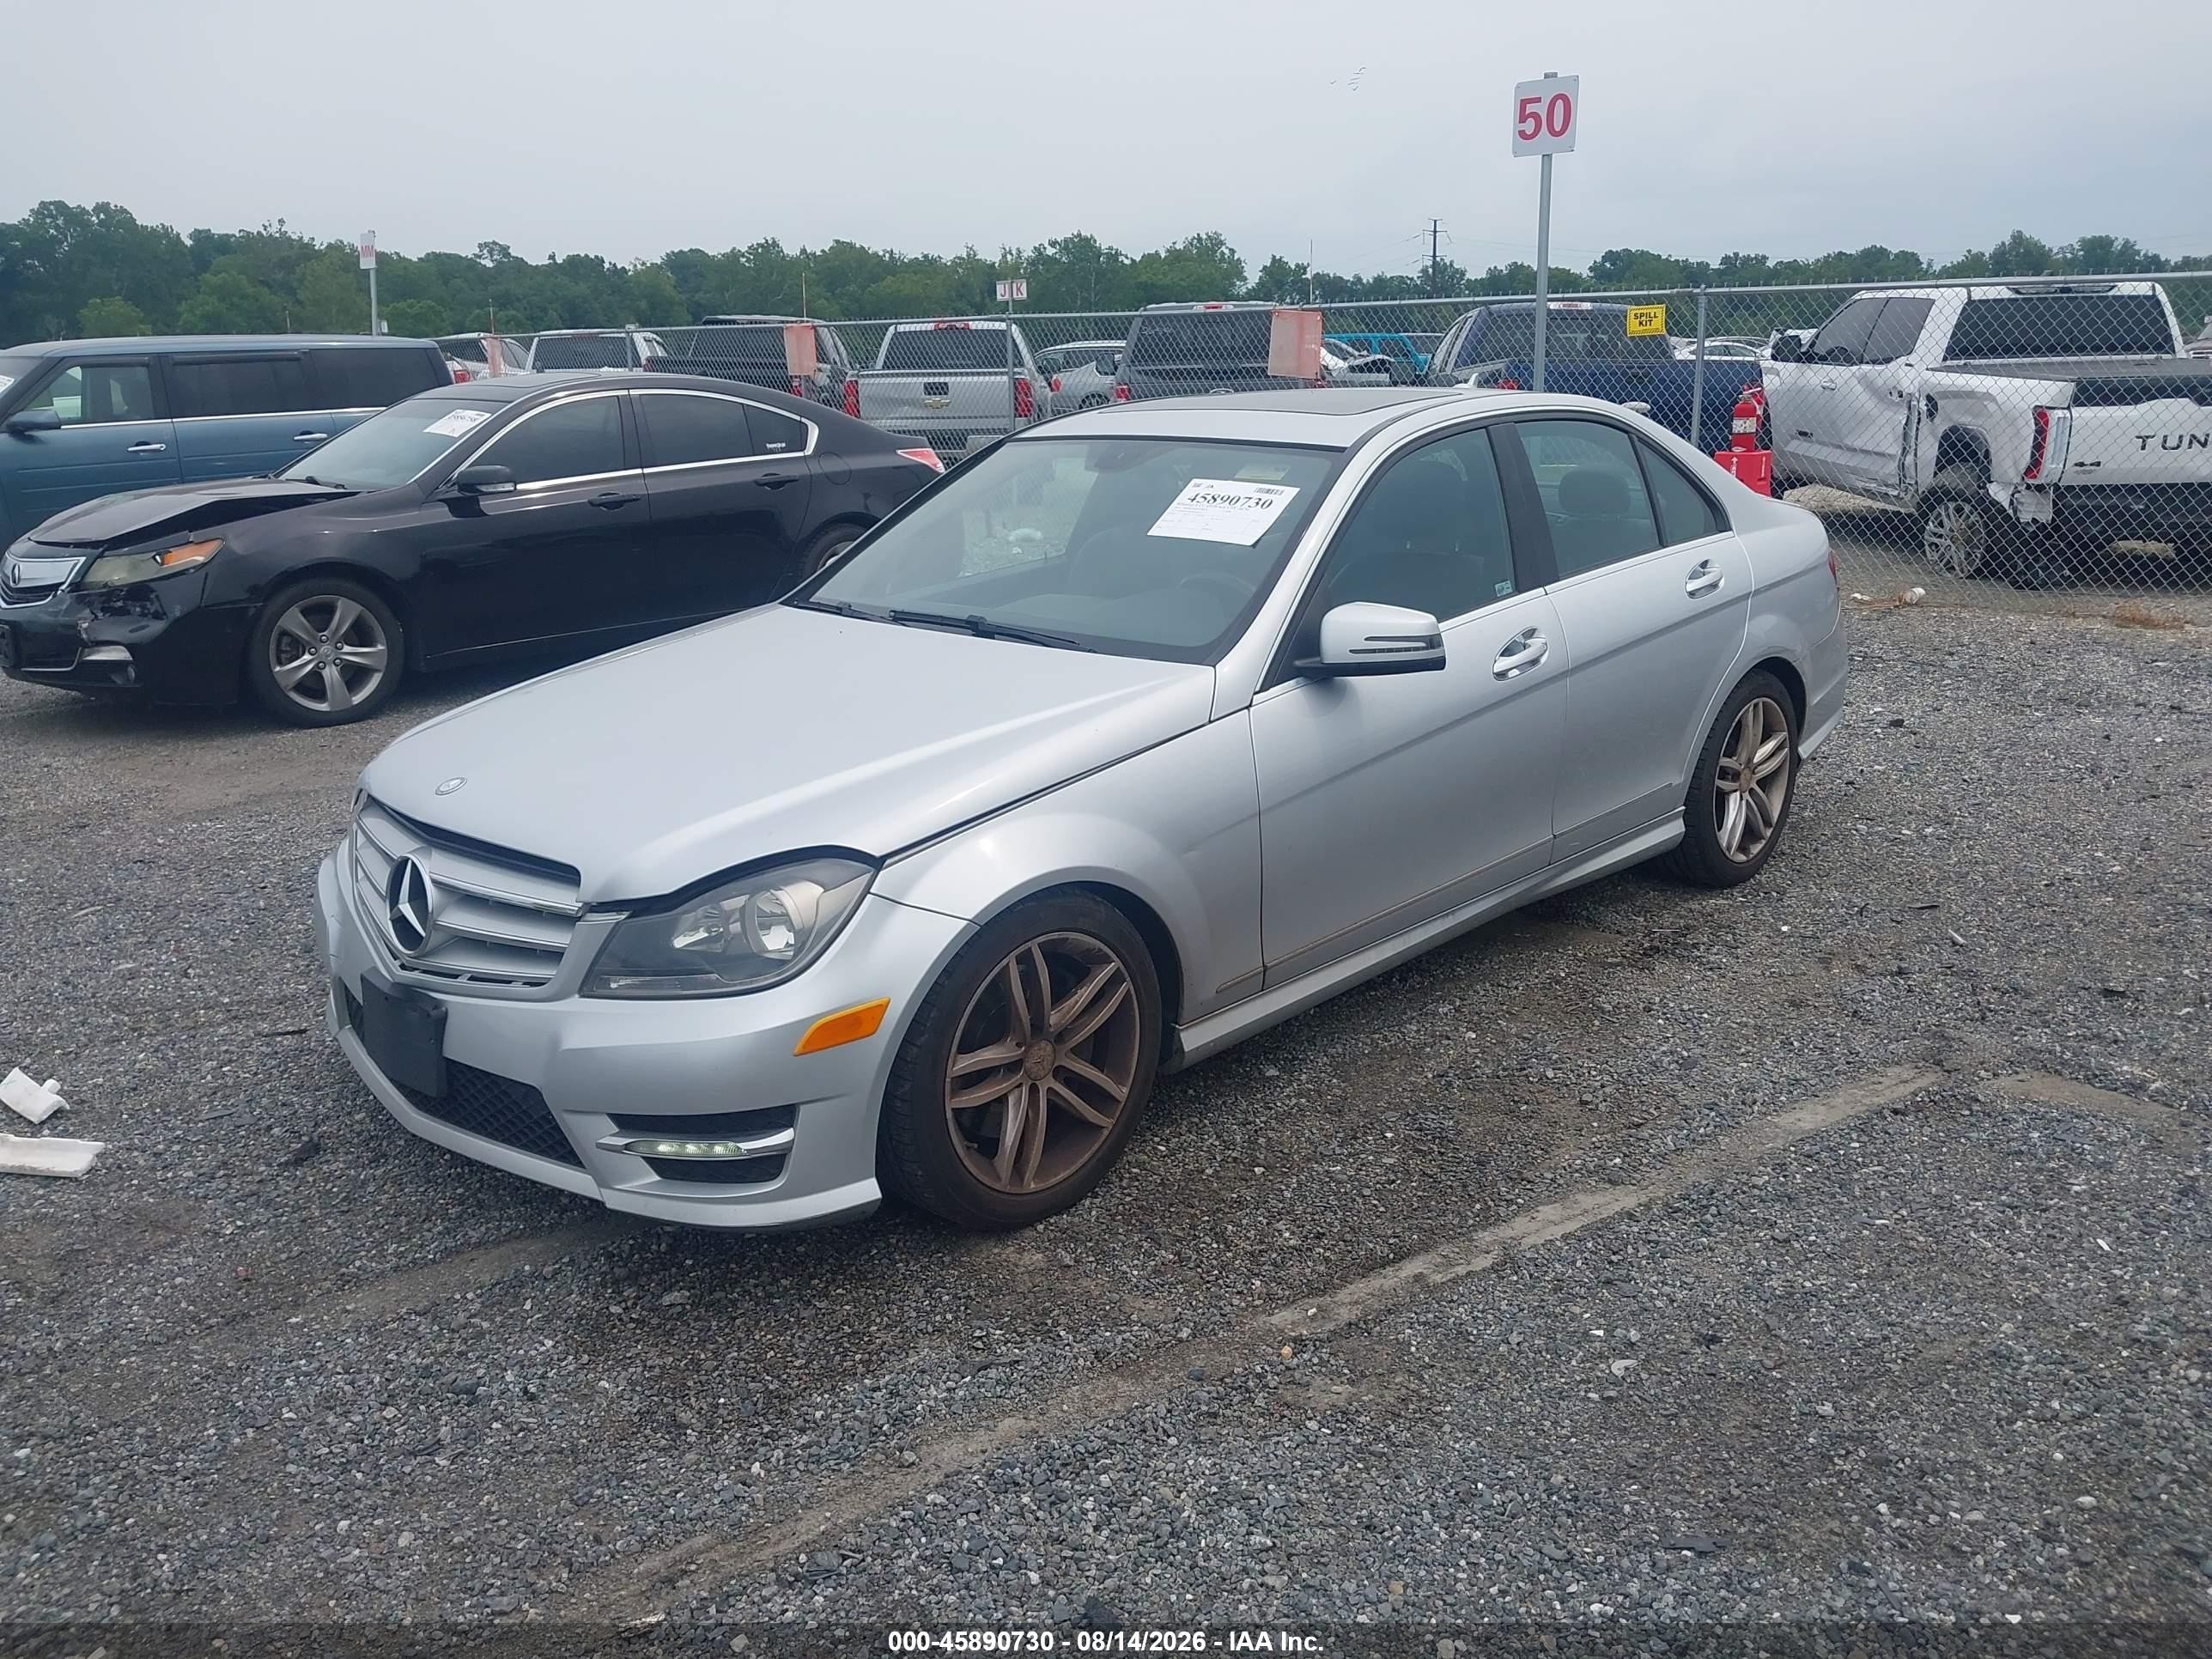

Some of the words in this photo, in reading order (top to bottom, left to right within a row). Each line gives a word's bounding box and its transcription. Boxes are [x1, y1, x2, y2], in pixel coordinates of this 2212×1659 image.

[1517, 93, 1572, 141] 50
[1000, 283, 1006, 297] J
[1016, 283, 1024, 296] K
[1633, 311, 1659, 320] SPILL
[1638, 319, 1654, 327] KIT
[2135, 433, 2210, 451] TUN
[1188, 492, 1273, 510] 45890730
